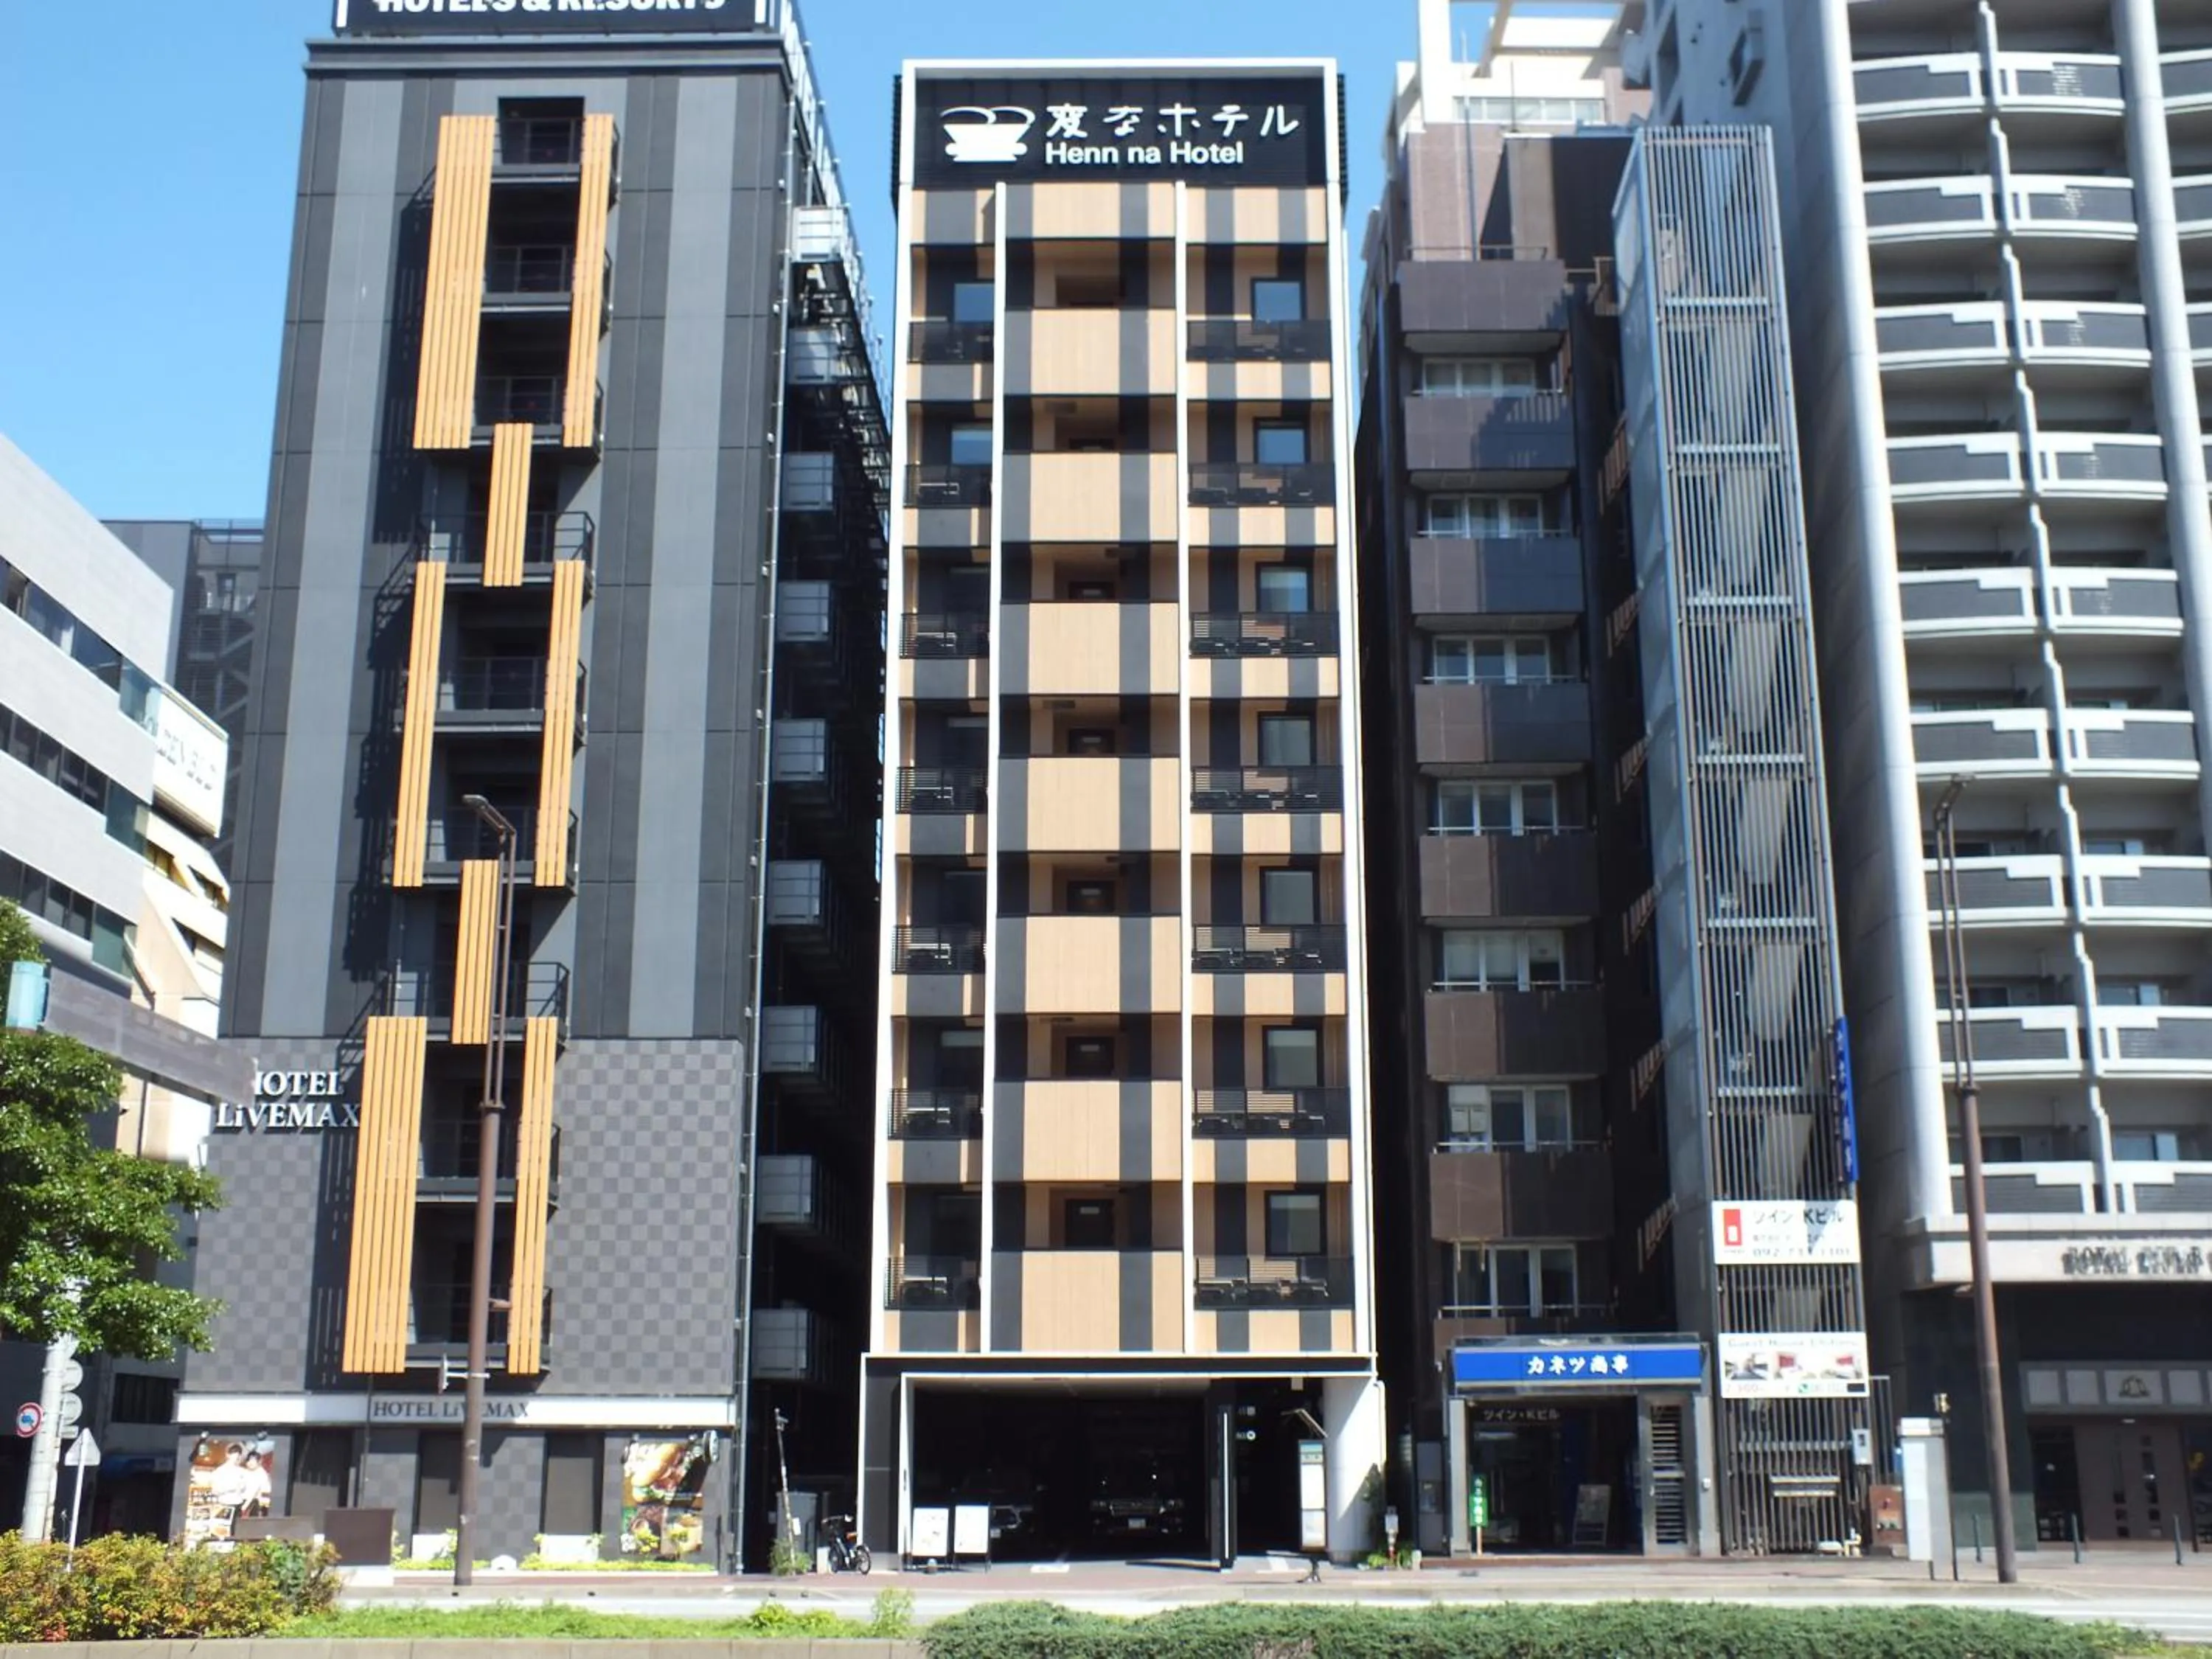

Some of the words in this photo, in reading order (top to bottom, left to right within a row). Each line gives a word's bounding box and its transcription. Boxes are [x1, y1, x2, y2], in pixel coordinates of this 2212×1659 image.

[1046, 102, 1301, 139] 変なホテル
[1046, 142, 1119, 164] Henn
[1128, 147, 1161, 164] na
[1170, 142, 1243, 164] Hotel
[373, 1401, 438, 1417] HOTEL
